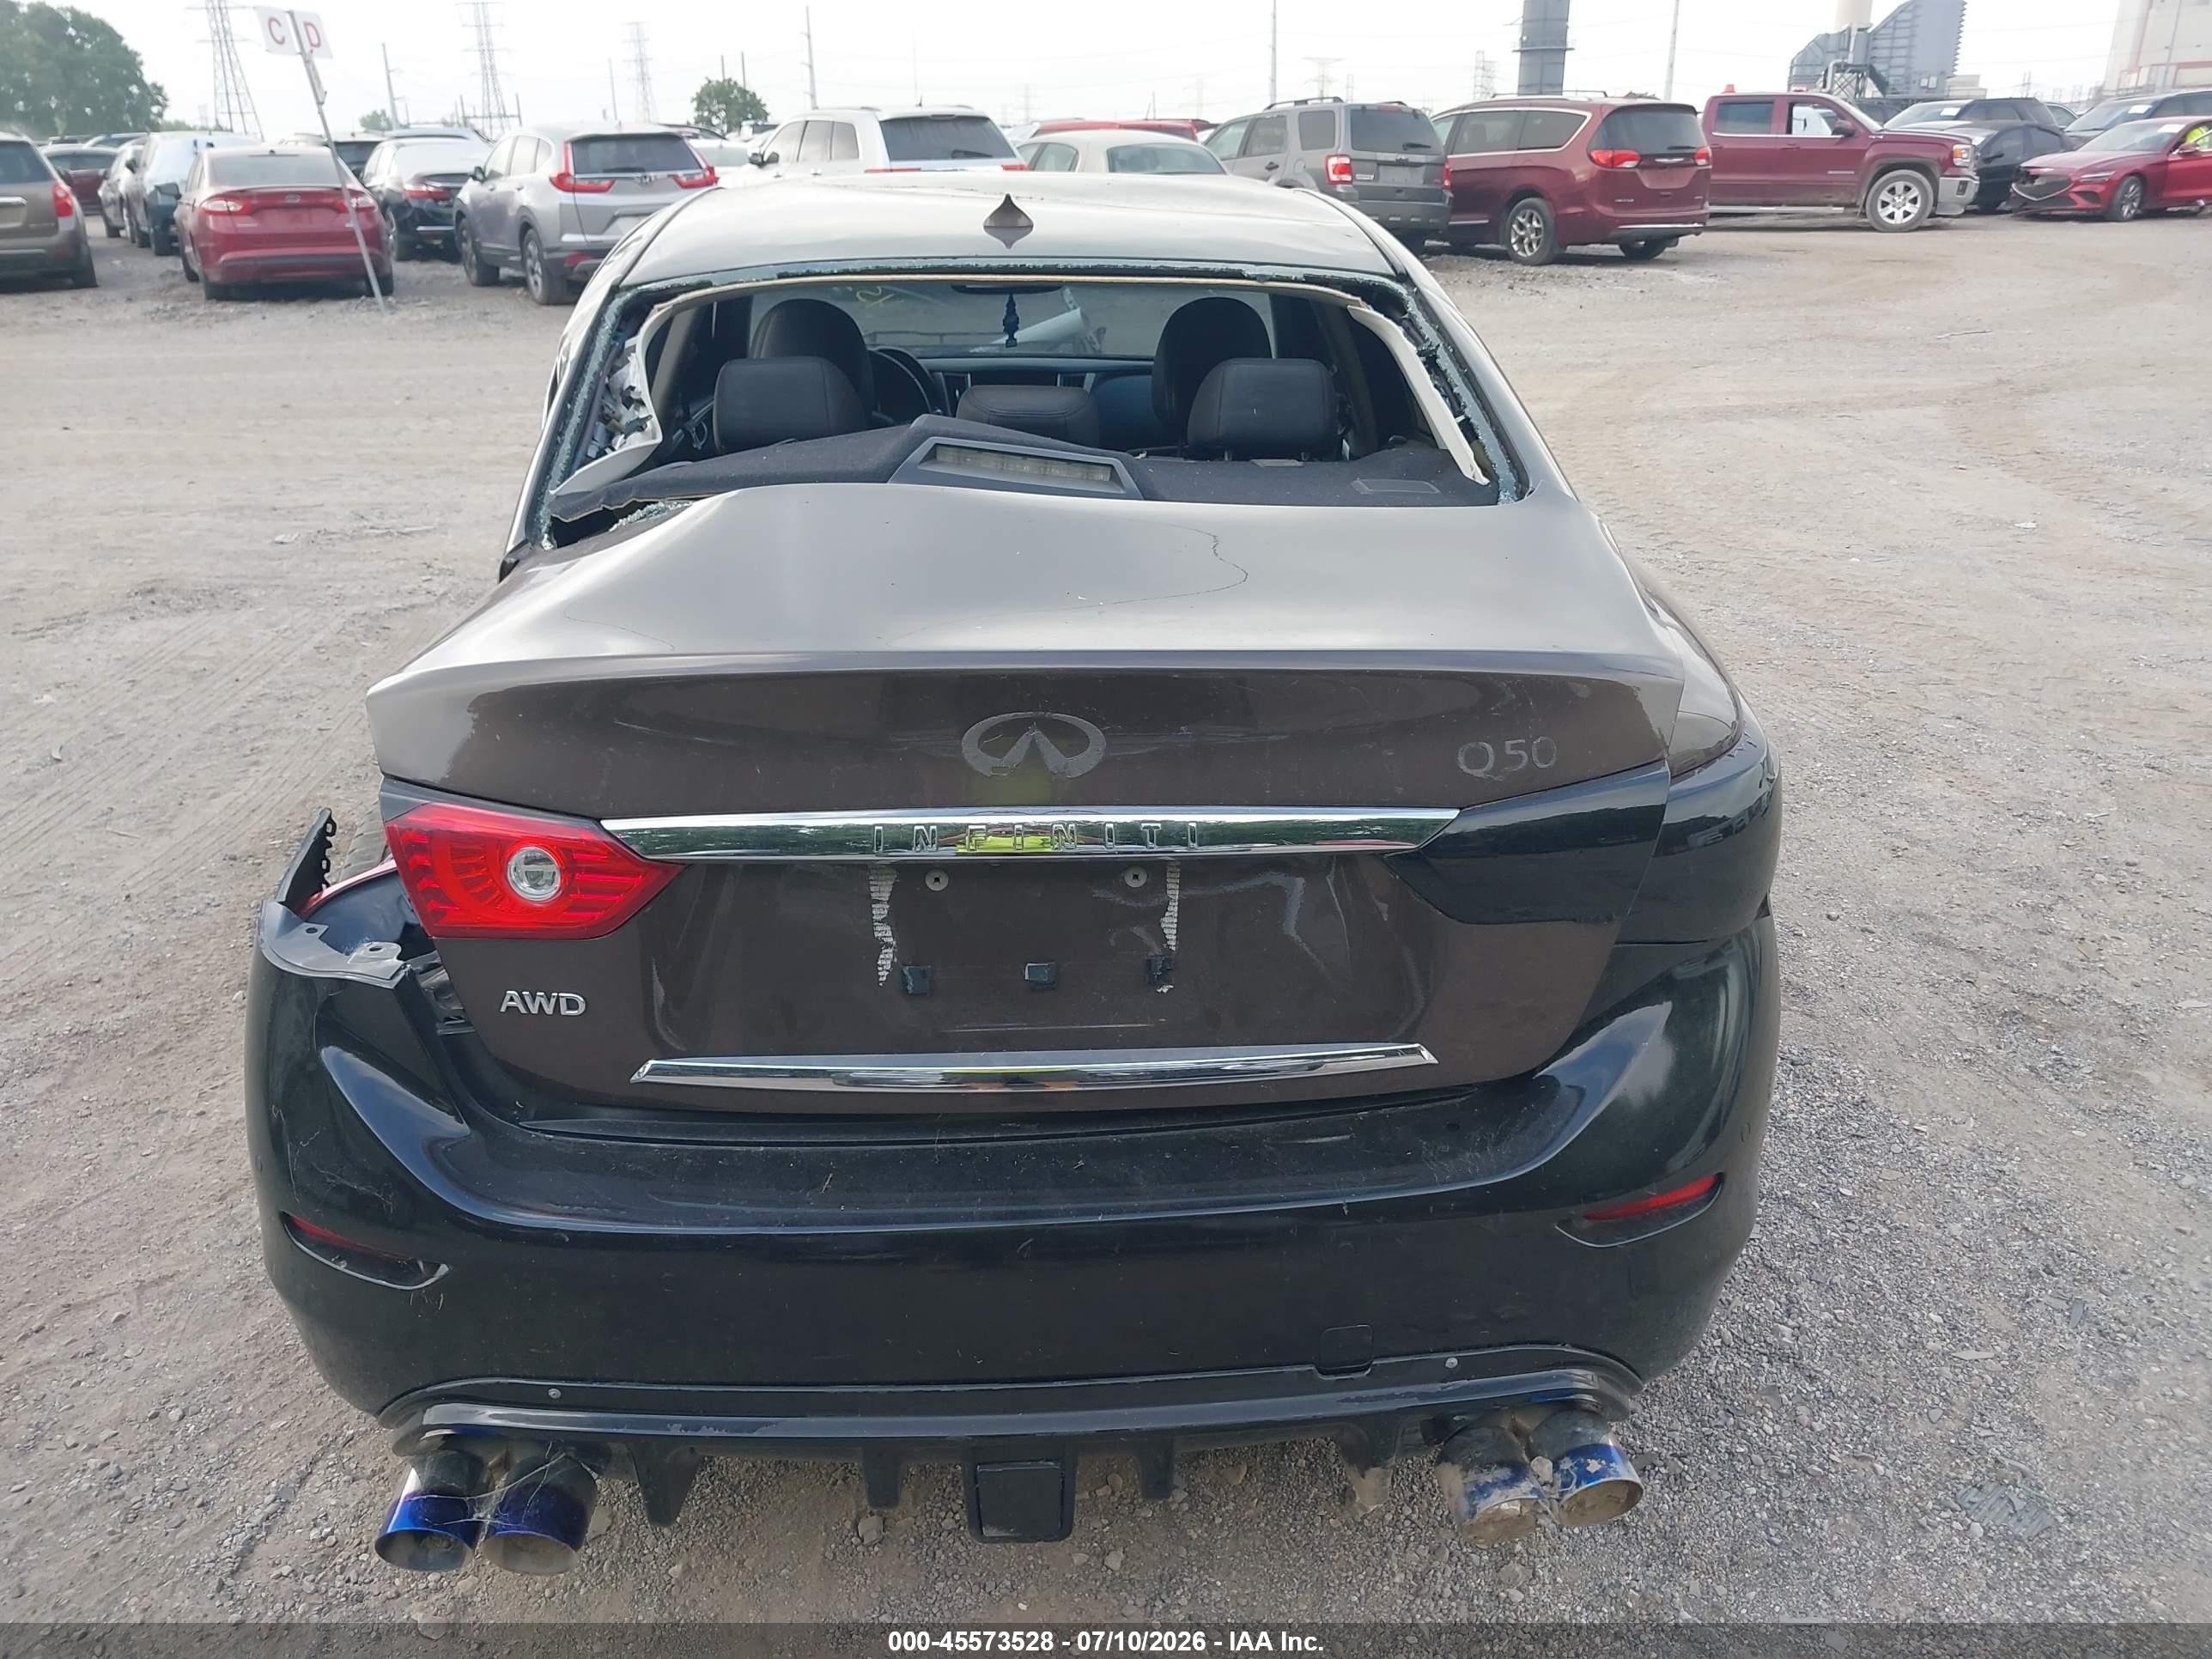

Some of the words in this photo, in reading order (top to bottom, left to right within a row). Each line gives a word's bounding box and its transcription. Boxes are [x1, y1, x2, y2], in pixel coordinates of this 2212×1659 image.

[267, 16, 286, 46] C
[302, 21, 322, 48] D
[1456, 735, 1558, 781] Q50
[872, 821, 1200, 853] INFINITI
[499, 990, 586, 1017] AWD
